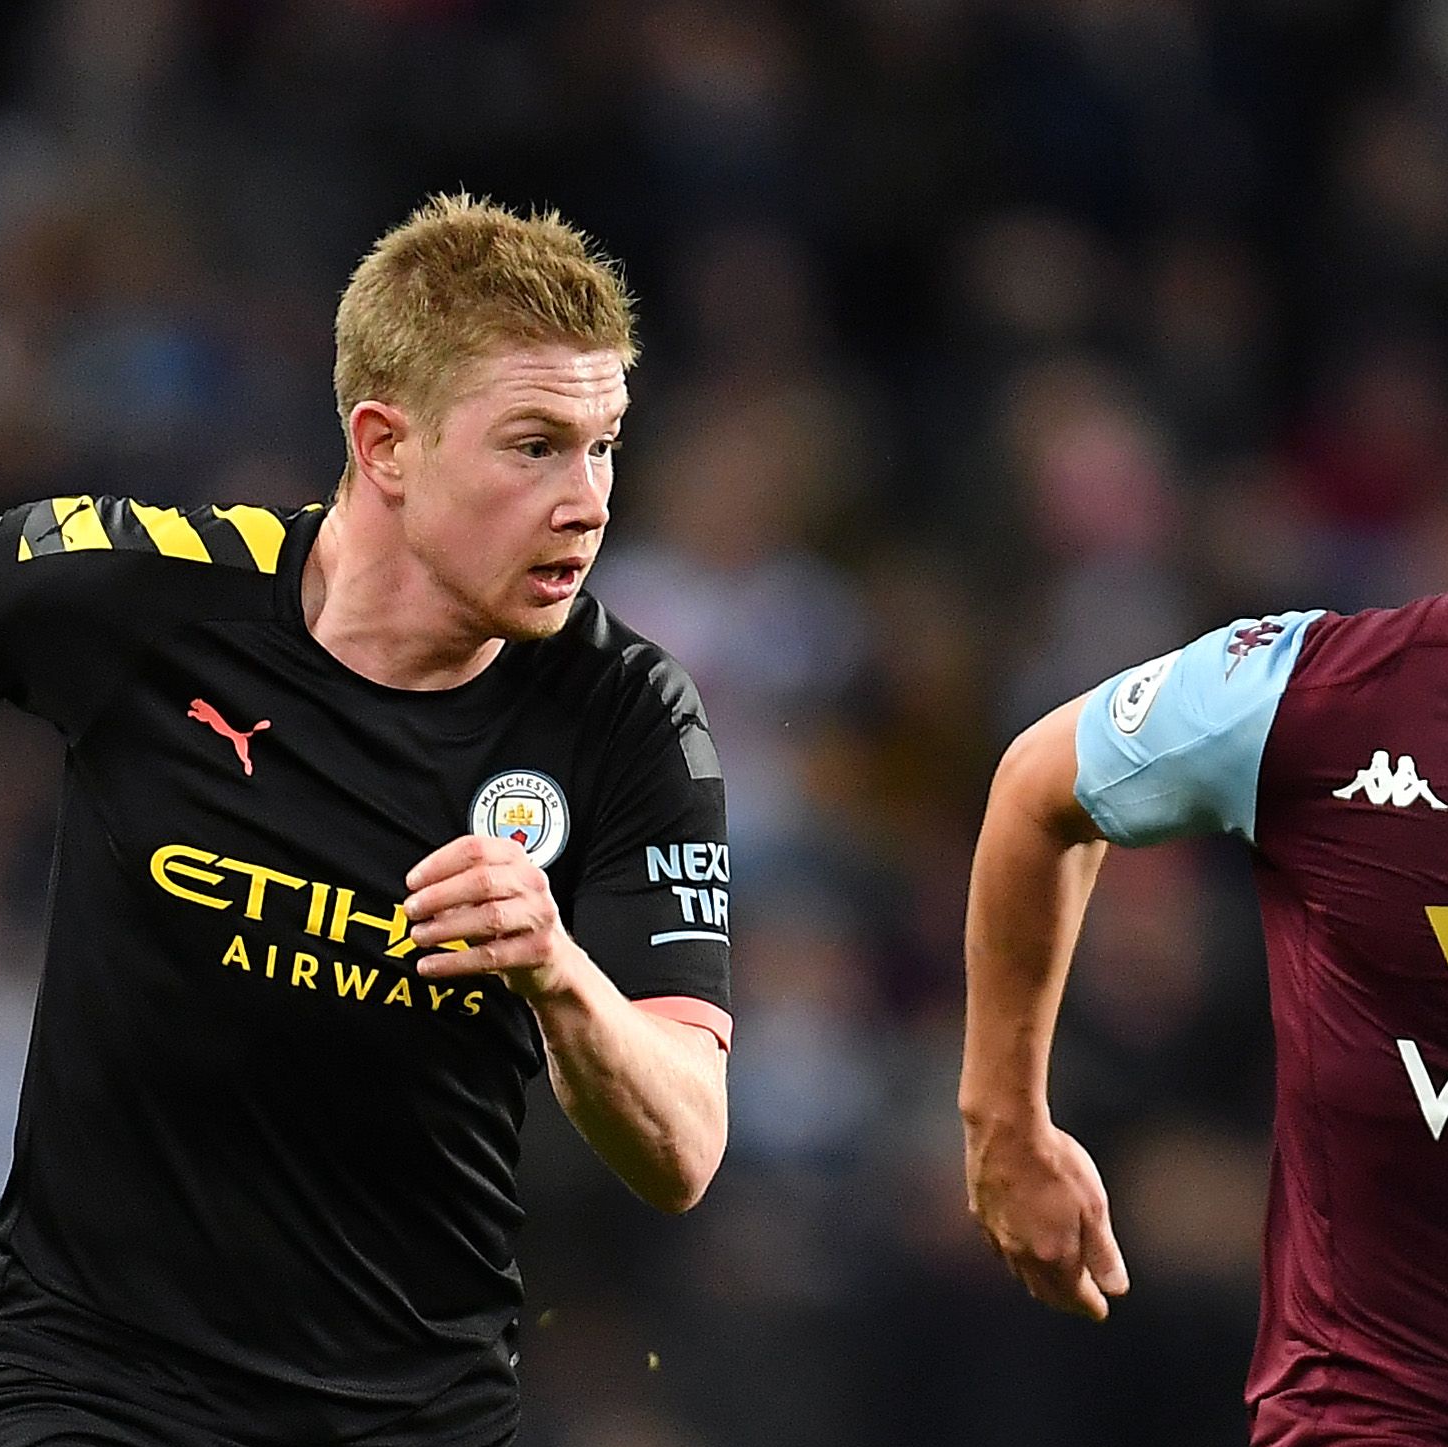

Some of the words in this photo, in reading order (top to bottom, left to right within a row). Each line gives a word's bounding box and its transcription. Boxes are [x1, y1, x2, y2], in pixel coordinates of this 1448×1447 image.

[480, 776, 559, 809] MANCHESTER
[149, 842, 471, 959] ETIH
[220, 934, 485, 1017] AIRWAYS
